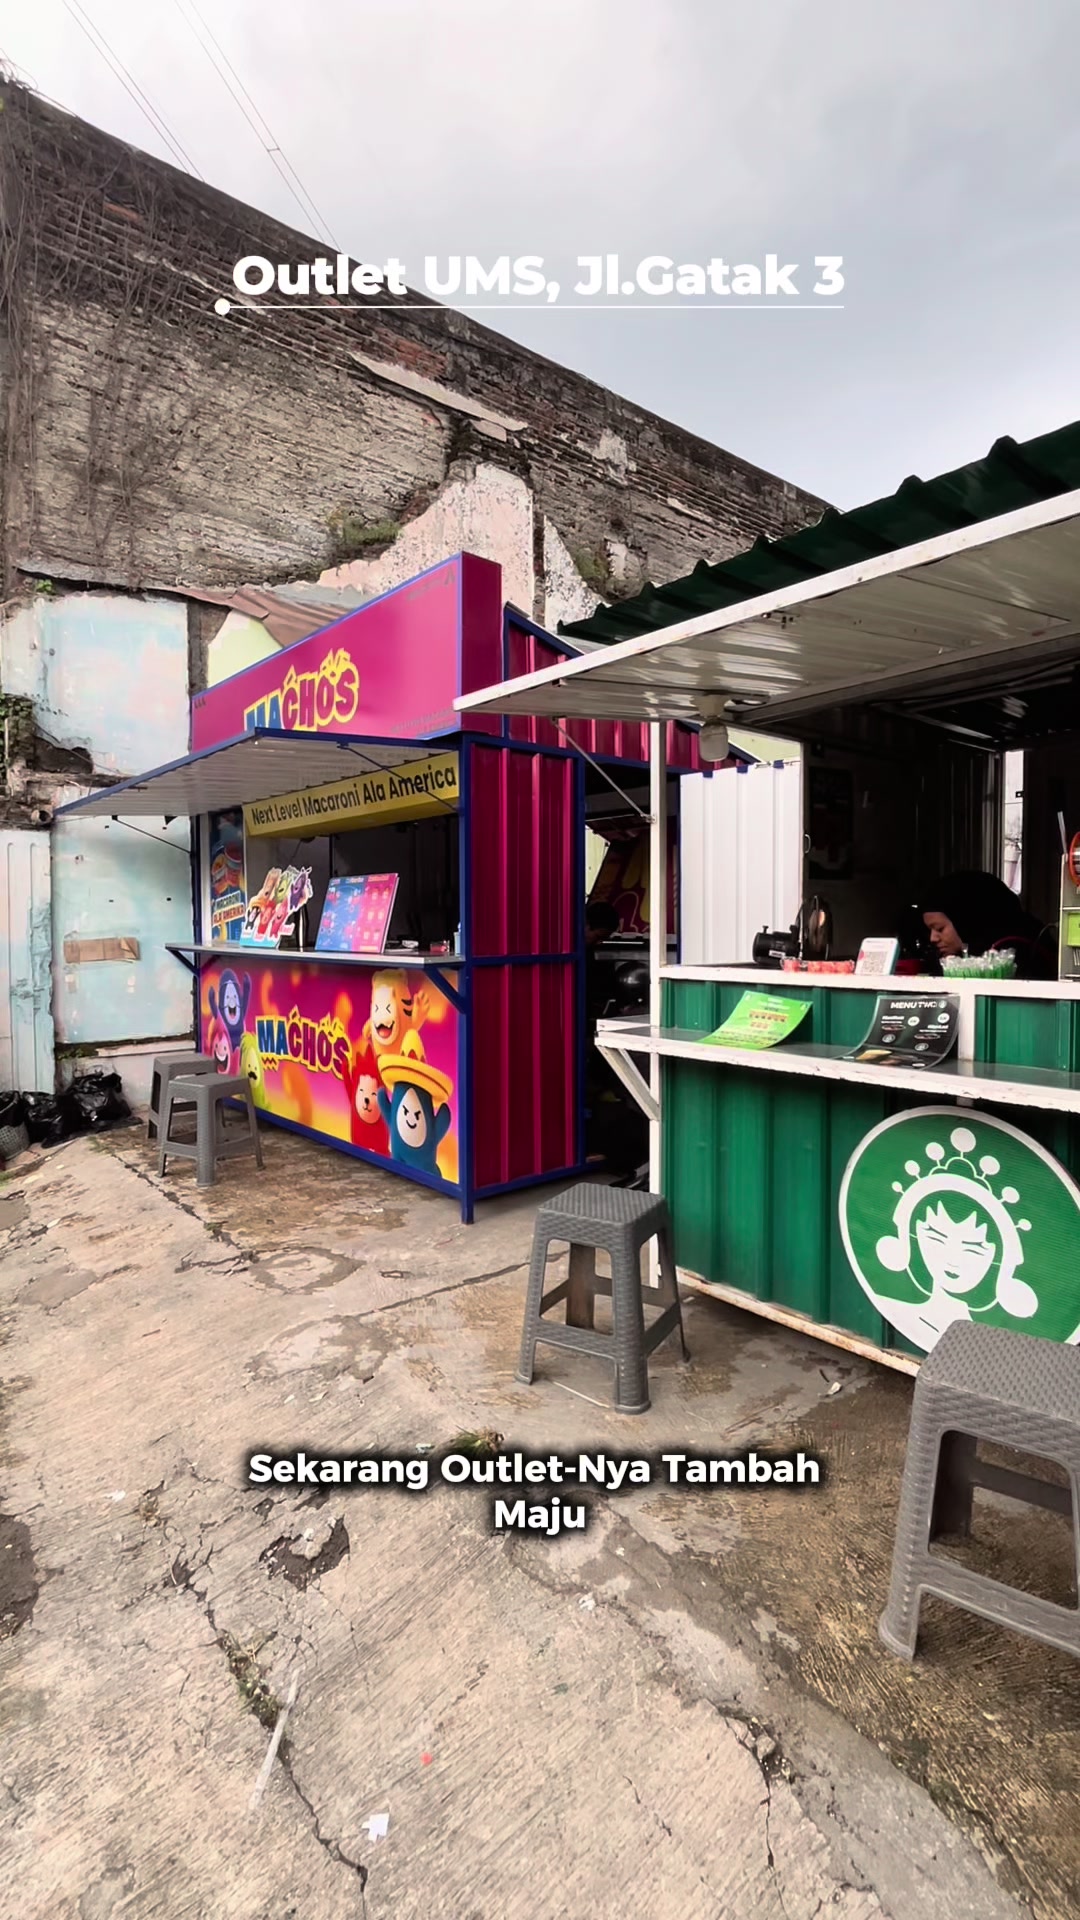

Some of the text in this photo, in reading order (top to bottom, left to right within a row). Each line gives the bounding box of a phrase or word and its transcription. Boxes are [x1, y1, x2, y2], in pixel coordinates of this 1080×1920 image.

[244, 652, 360, 732] MACHOS
[252, 764, 457, 826] Next Level Macaroni Ala America
[890, 1001, 917, 1009] MENU
[255, 1010, 352, 1080] MACHOS
